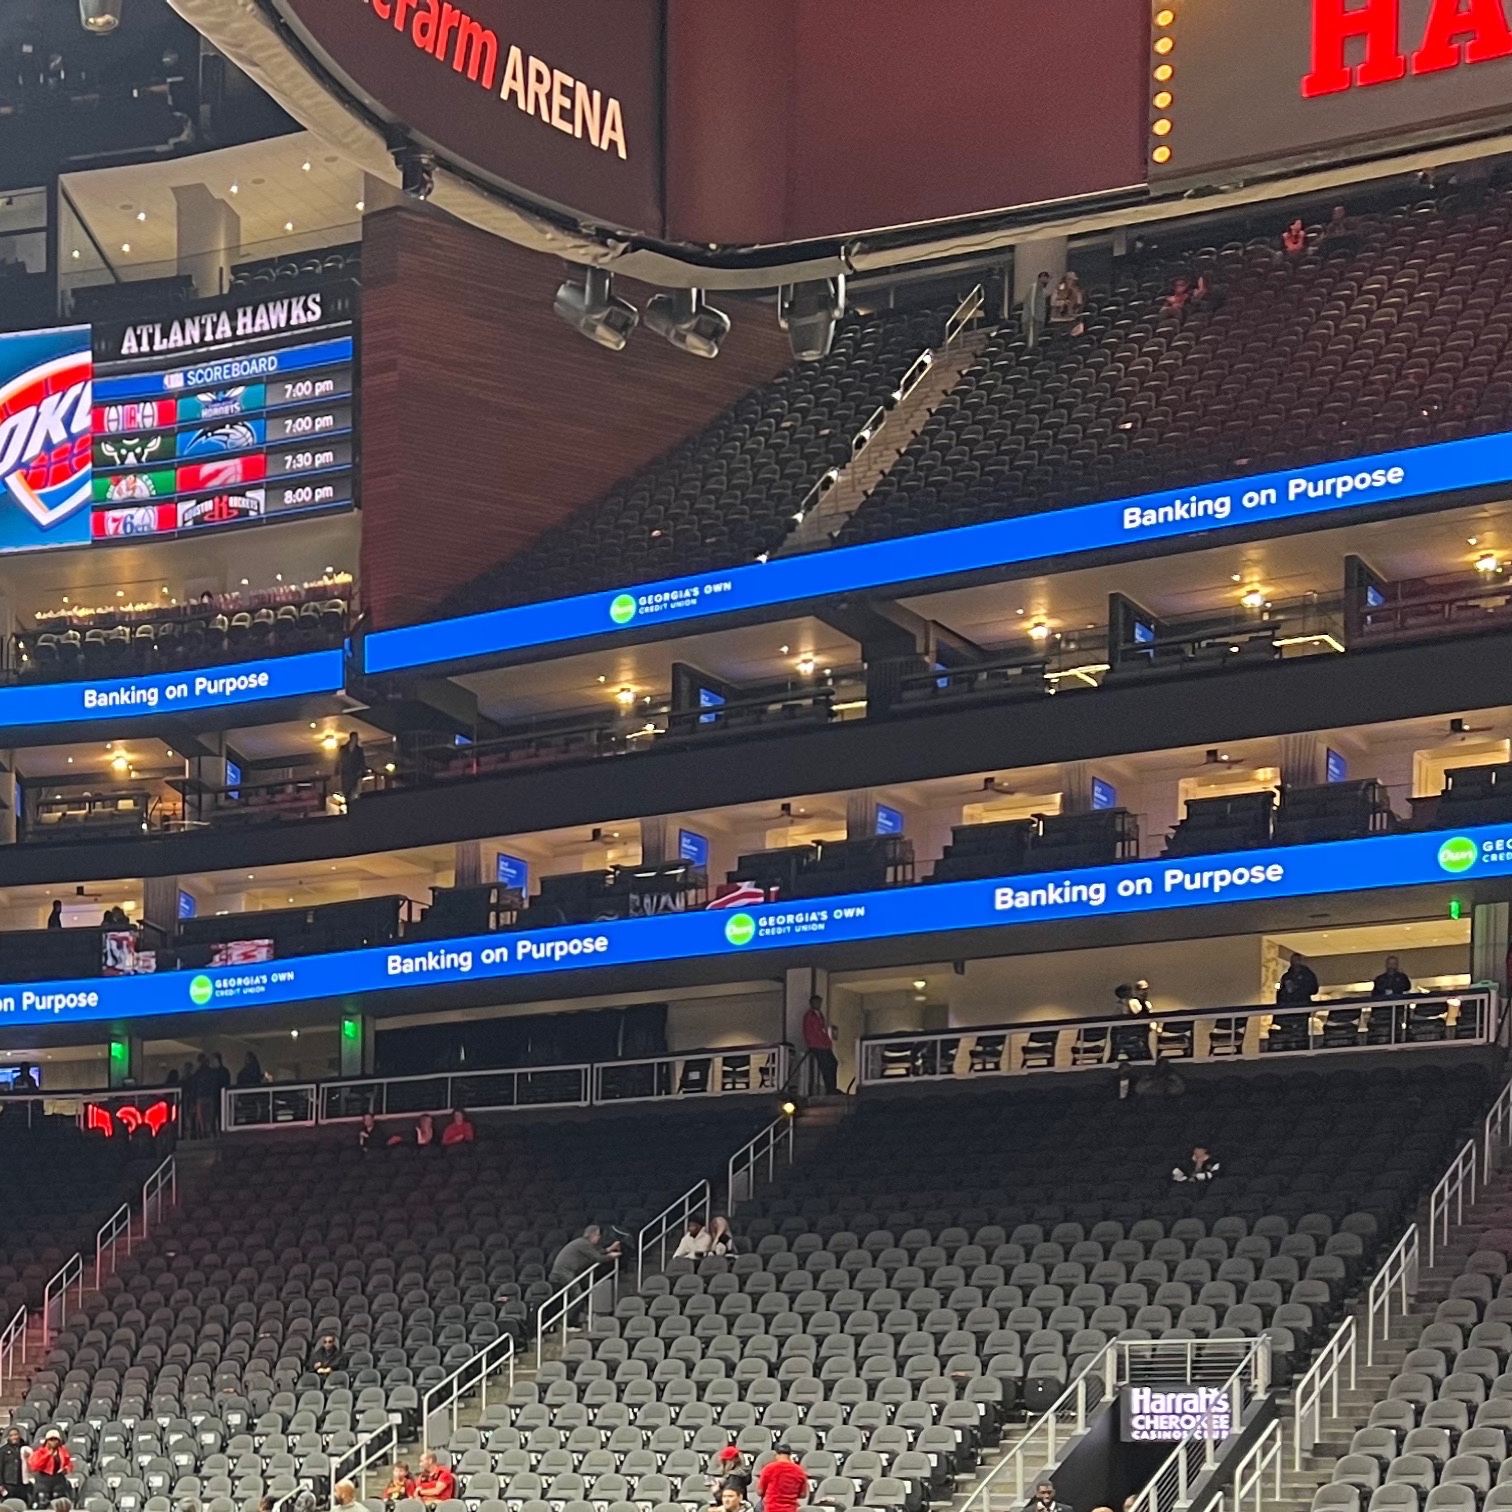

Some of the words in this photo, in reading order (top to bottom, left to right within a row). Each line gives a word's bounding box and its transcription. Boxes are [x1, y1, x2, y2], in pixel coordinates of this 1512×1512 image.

[499, 44, 627, 160] ARENA
[121, 311, 232, 354] ATLANTA
[236, 293, 322, 336] HAWKS
[187, 356, 278, 386] SCOREBOARD
[284, 381, 313, 399] 7:00
[315, 380, 334, 396] pm
[284, 418, 313, 434] 7:00
[315, 415, 334, 431] pm
[284, 453, 313, 470] 7:30
[315, 451, 334, 467] pm
[284, 489, 313, 505] 8:00
[315, 486, 334, 502] pm
[1123, 496, 1231, 529] Banking
[1242, 488, 1276, 508] on
[1288, 466, 1405, 500] Purpose
[638, 587, 699, 605] GEORGIA'S
[704, 581, 732, 594] OWN
[84, 685, 159, 708] Banking
[165, 683, 188, 700] on
[195, 672, 269, 696] Purpose
[994, 880, 1106, 910] Banking
[1117, 877, 1152, 896] on
[1164, 863, 1284, 892] Purpose
[758, 910, 828, 927] GEORGIA'S
[833, 906, 865, 920] OWN
[758, 925, 791, 937] CREDIT
[795, 923, 825, 933] UNION
[387, 949, 473, 975] Banking
[481, 946, 508, 964] on
[517, 936, 609, 961] Purpose
[215, 974, 268, 988] GEORGIA'S
[271, 971, 294, 983] OWN
[22, 990, 99, 1013] Purpose
